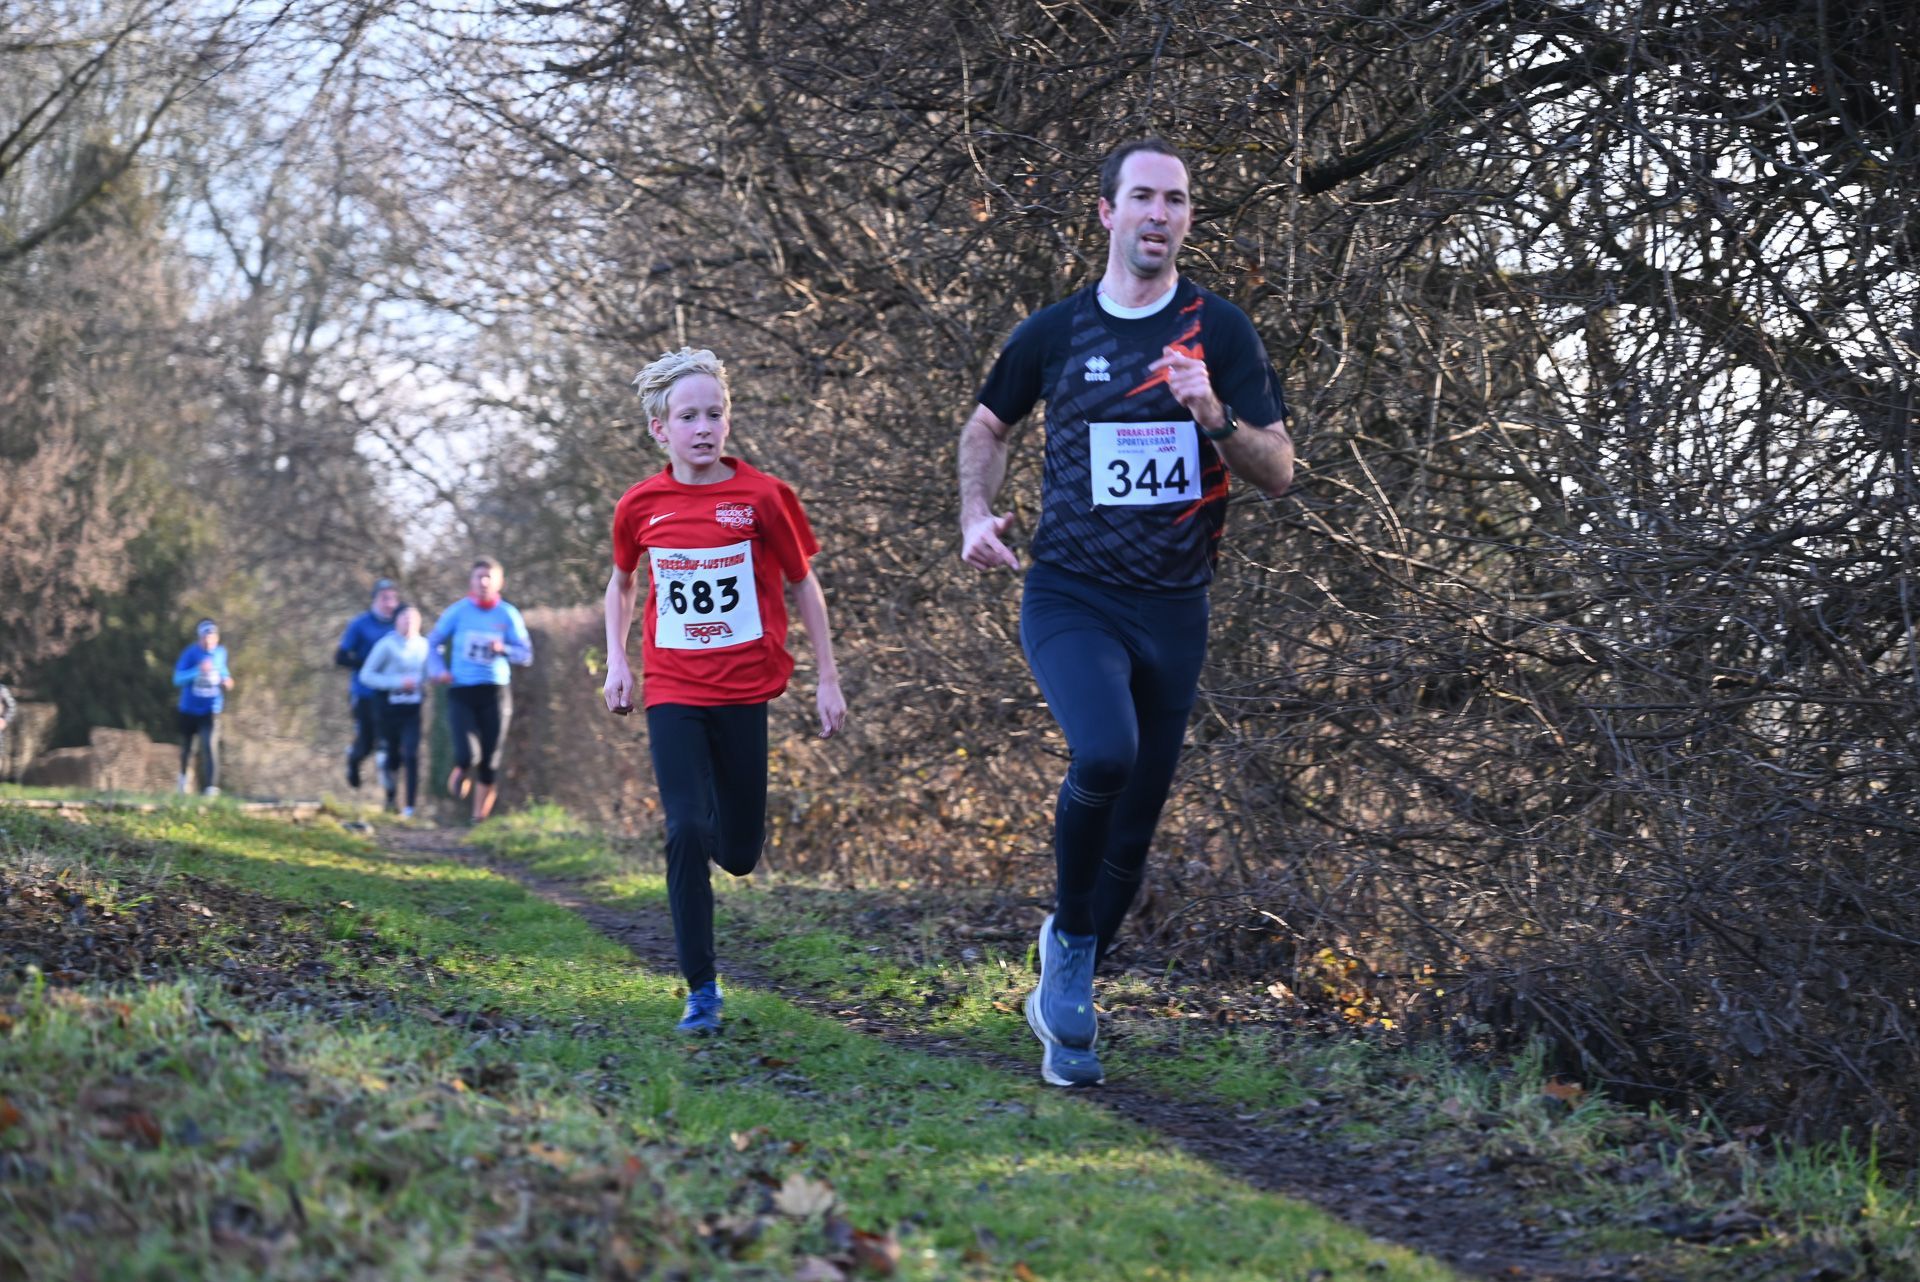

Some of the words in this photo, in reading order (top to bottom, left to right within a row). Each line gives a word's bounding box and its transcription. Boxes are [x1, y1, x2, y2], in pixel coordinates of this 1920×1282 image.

[1116, 427, 1176, 437] VORARLBERGER
[1107, 456, 1190, 498] 344
[669, 576, 740, 615] 683
